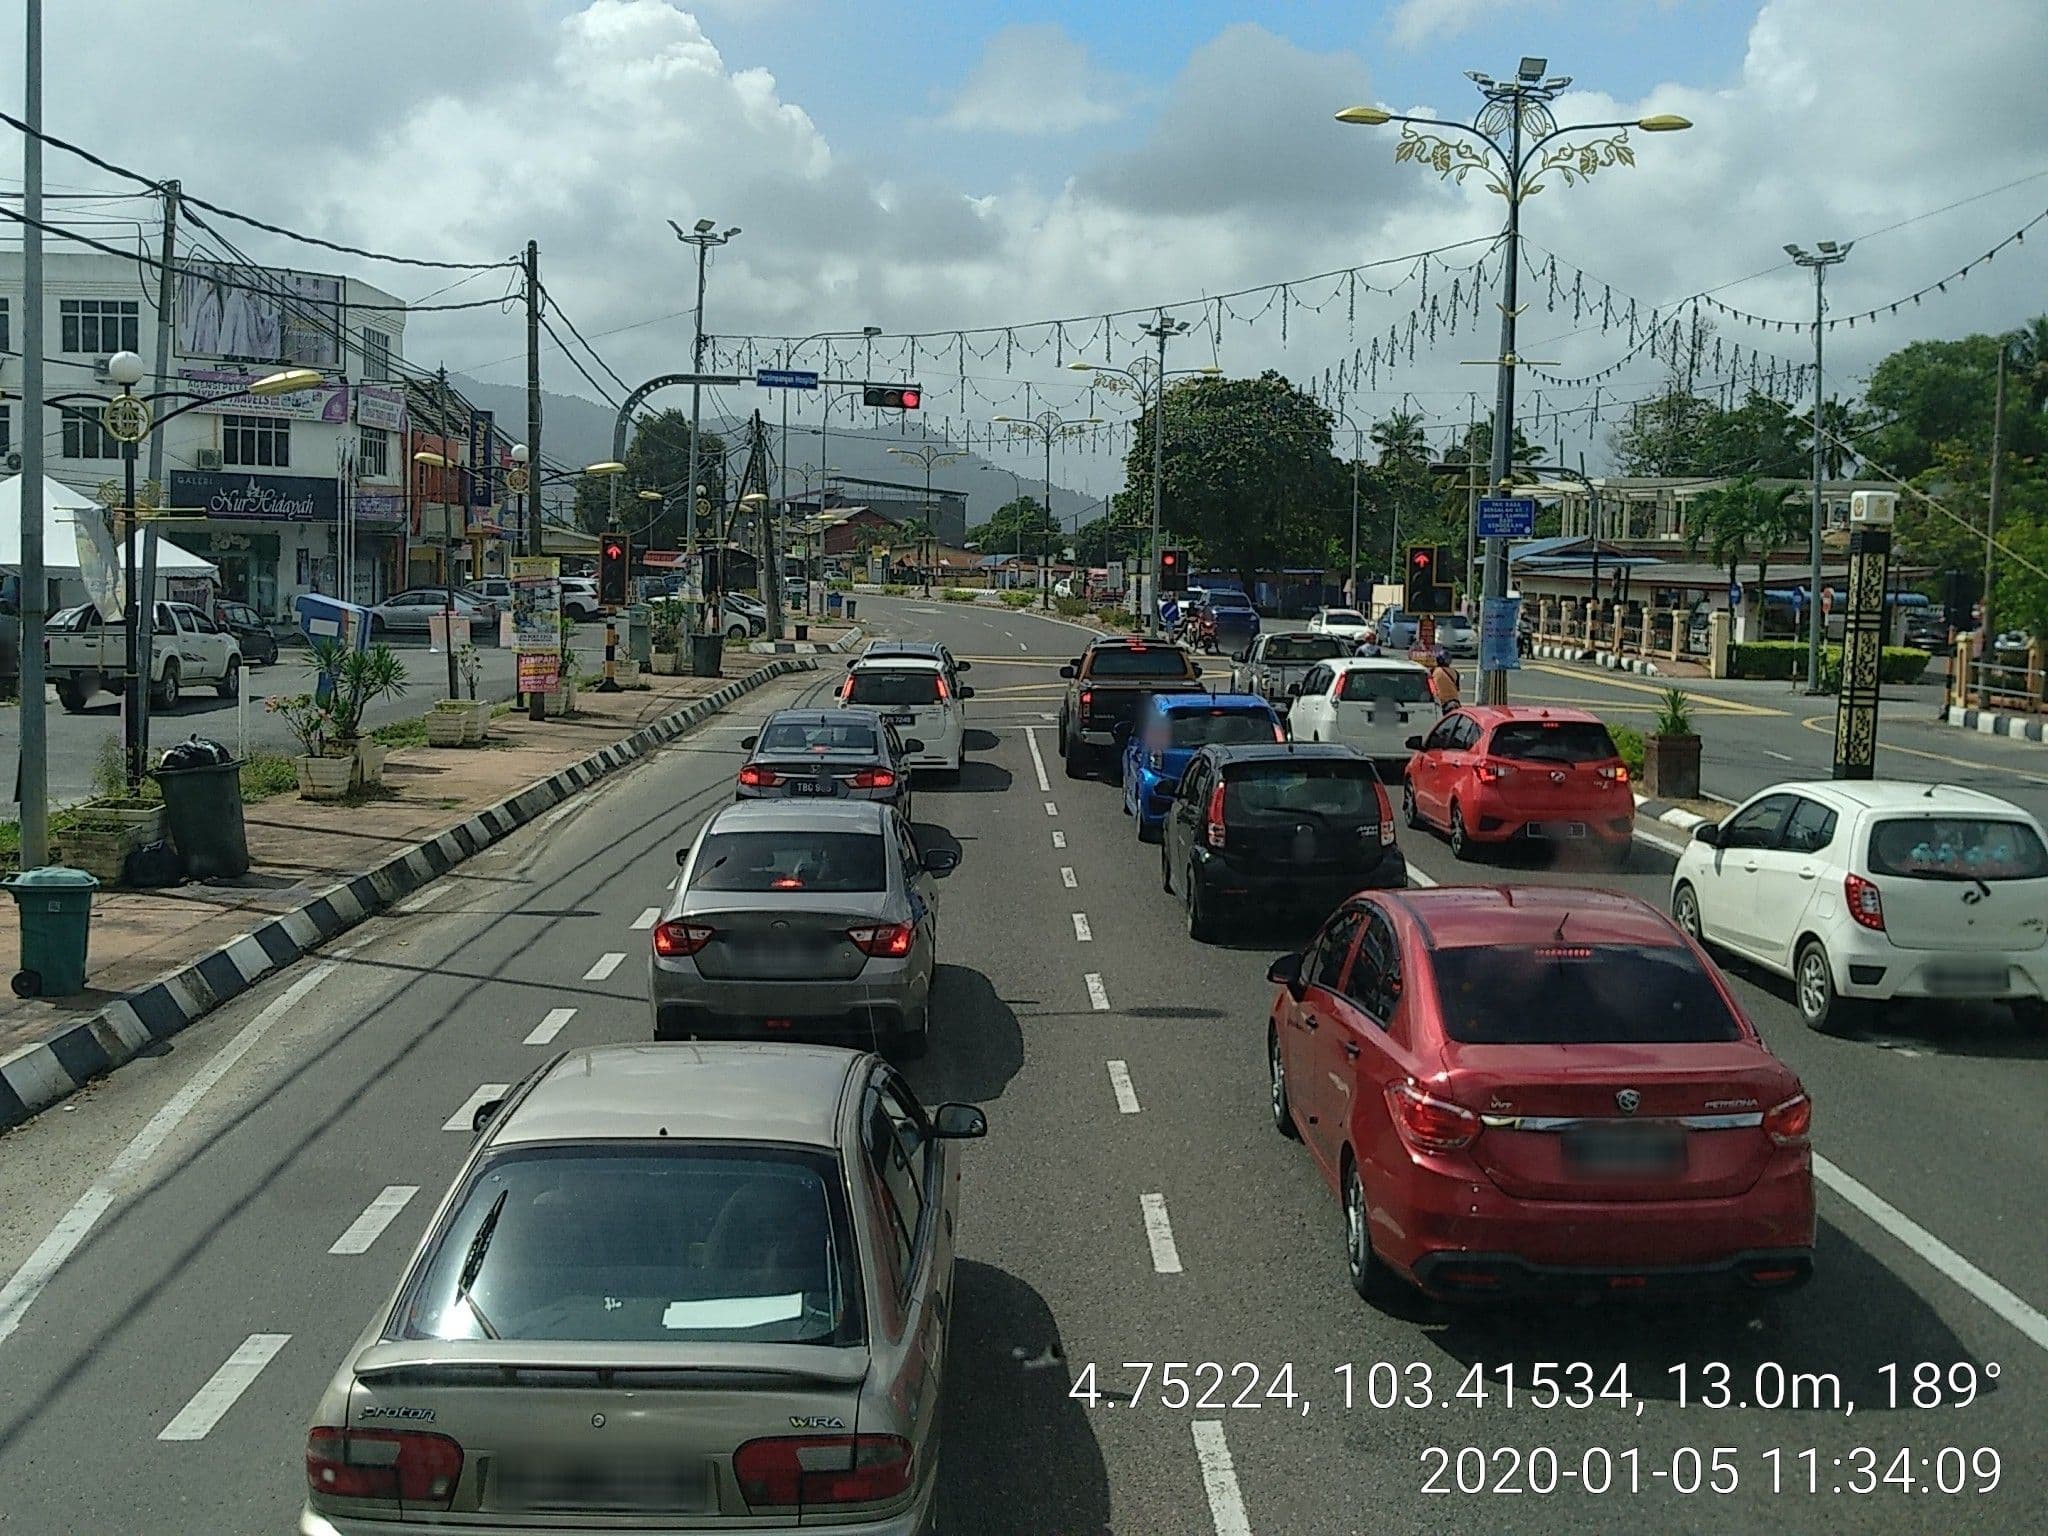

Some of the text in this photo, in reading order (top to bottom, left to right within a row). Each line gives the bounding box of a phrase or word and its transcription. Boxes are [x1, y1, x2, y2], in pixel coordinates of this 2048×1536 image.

[210, 487, 314, 520] Nur Hidayah
[789, 1416, 845, 1428] WIRA
